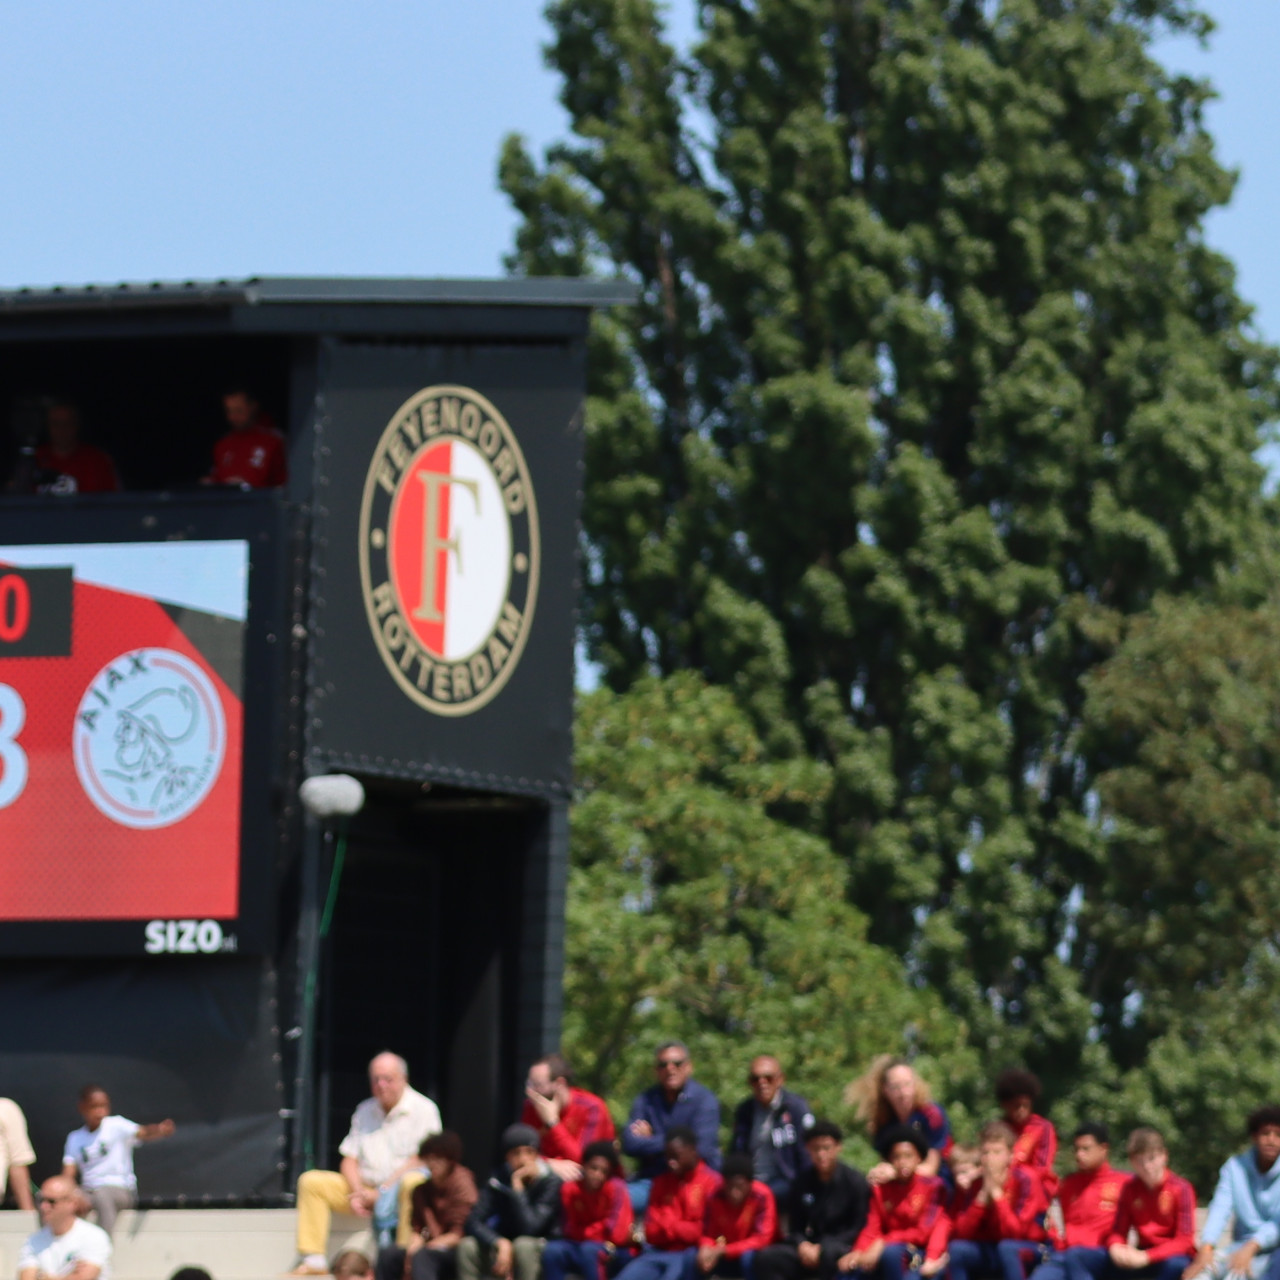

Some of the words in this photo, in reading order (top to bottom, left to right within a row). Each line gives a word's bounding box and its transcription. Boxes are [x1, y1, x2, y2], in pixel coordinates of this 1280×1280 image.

[376, 397, 525, 516] FEYENOORD
[412, 469, 482, 624] F
[78, 651, 149, 735] AJAX
[372, 580, 524, 702] ROTTERDAM
